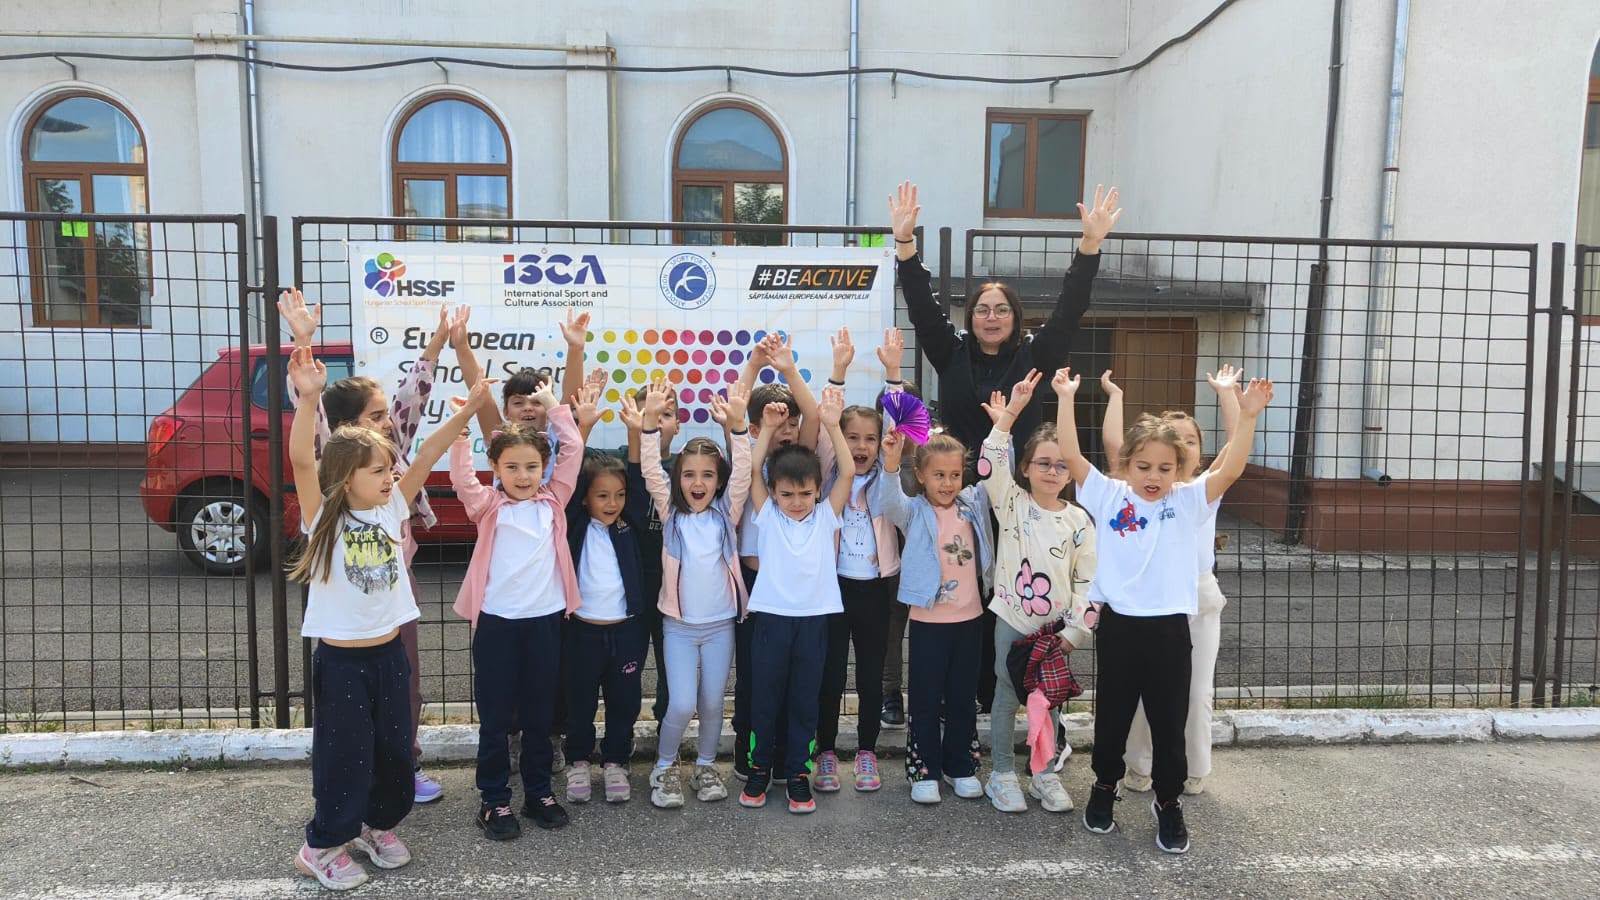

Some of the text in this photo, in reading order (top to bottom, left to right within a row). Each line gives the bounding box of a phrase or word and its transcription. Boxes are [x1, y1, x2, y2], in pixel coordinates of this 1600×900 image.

[757, 268, 873, 286] #BEACTIVE
[396, 280, 455, 297] HSSF
[504, 289, 608, 299] International Sport and
[504, 298, 593, 307] Culture Association
